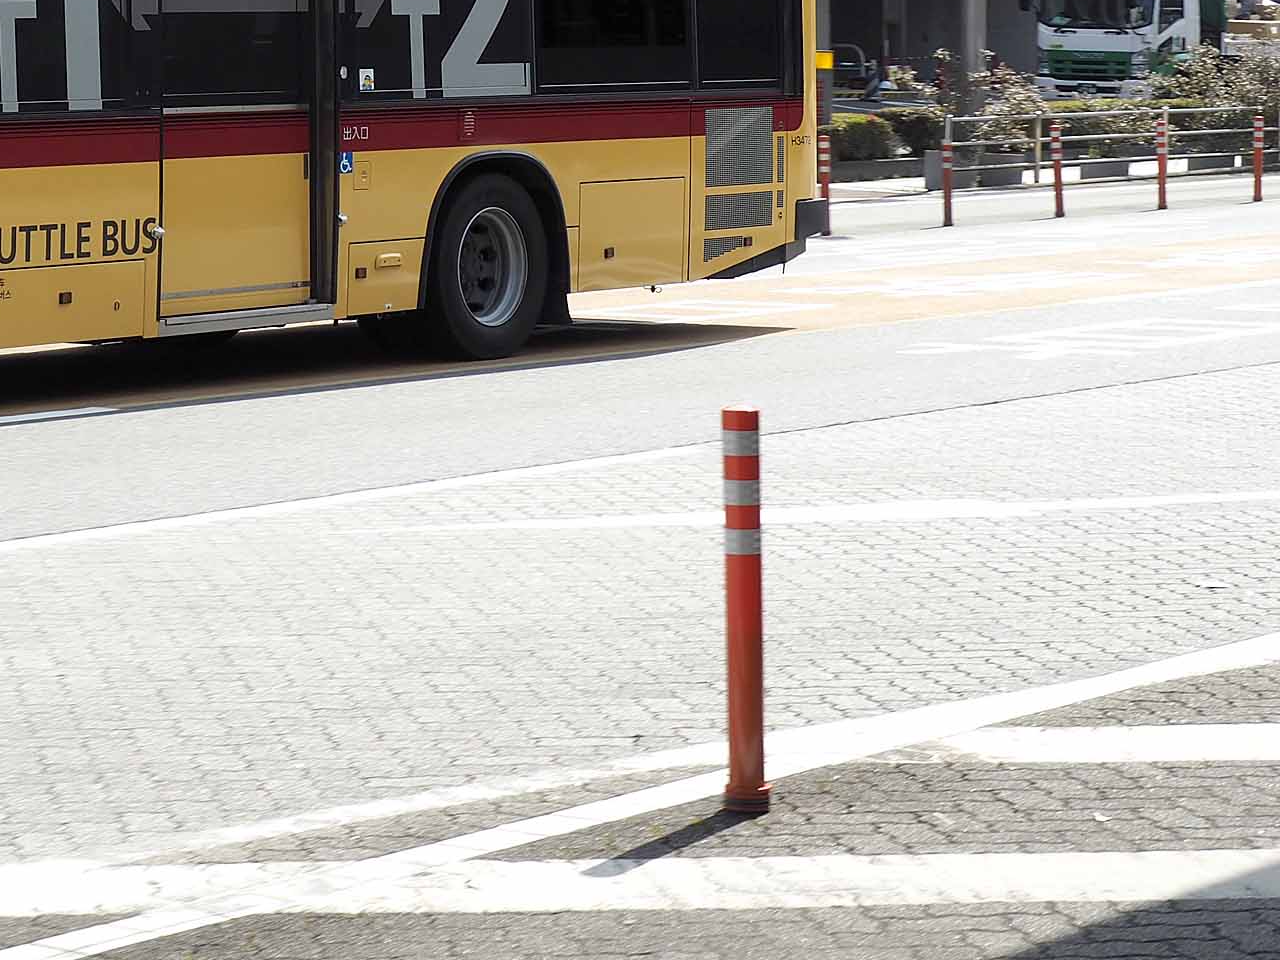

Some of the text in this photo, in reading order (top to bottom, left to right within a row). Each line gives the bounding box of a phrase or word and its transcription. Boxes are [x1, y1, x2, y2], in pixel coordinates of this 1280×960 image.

[343, 126, 369, 141] 出入口
[102, 216, 157, 256] BUS
